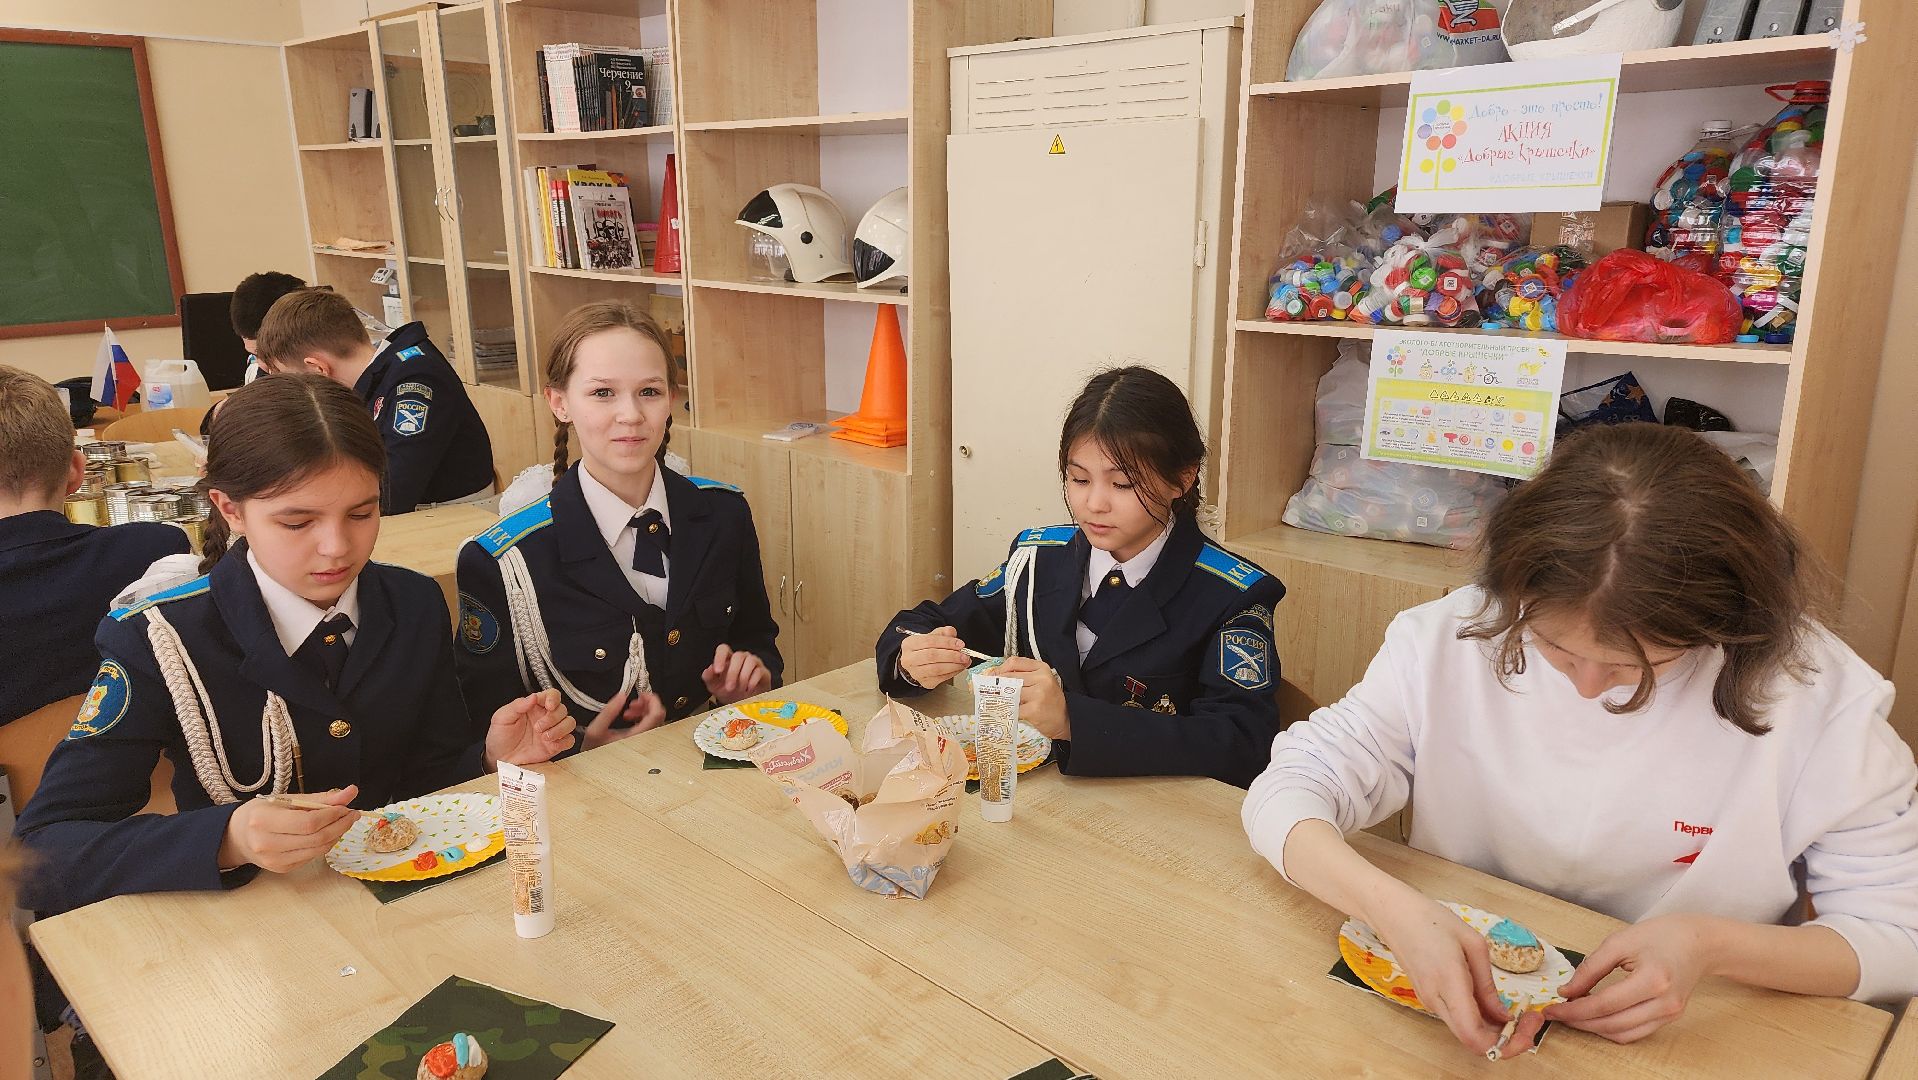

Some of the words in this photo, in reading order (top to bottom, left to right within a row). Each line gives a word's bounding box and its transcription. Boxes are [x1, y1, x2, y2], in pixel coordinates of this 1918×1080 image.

[599, 67, 644, 81] Черчение
[624, 80, 631, 91] 9
[1468, 103, 1509, 121] Добро
[1521, 103, 1545, 114] это
[1551, 93, 1604, 118] просто!
[1498, 121, 1552, 143] АКЦИЯ
[397, 403, 427, 412] РОССИЯ
[1224, 634, 1265, 650] РОССИЯ
